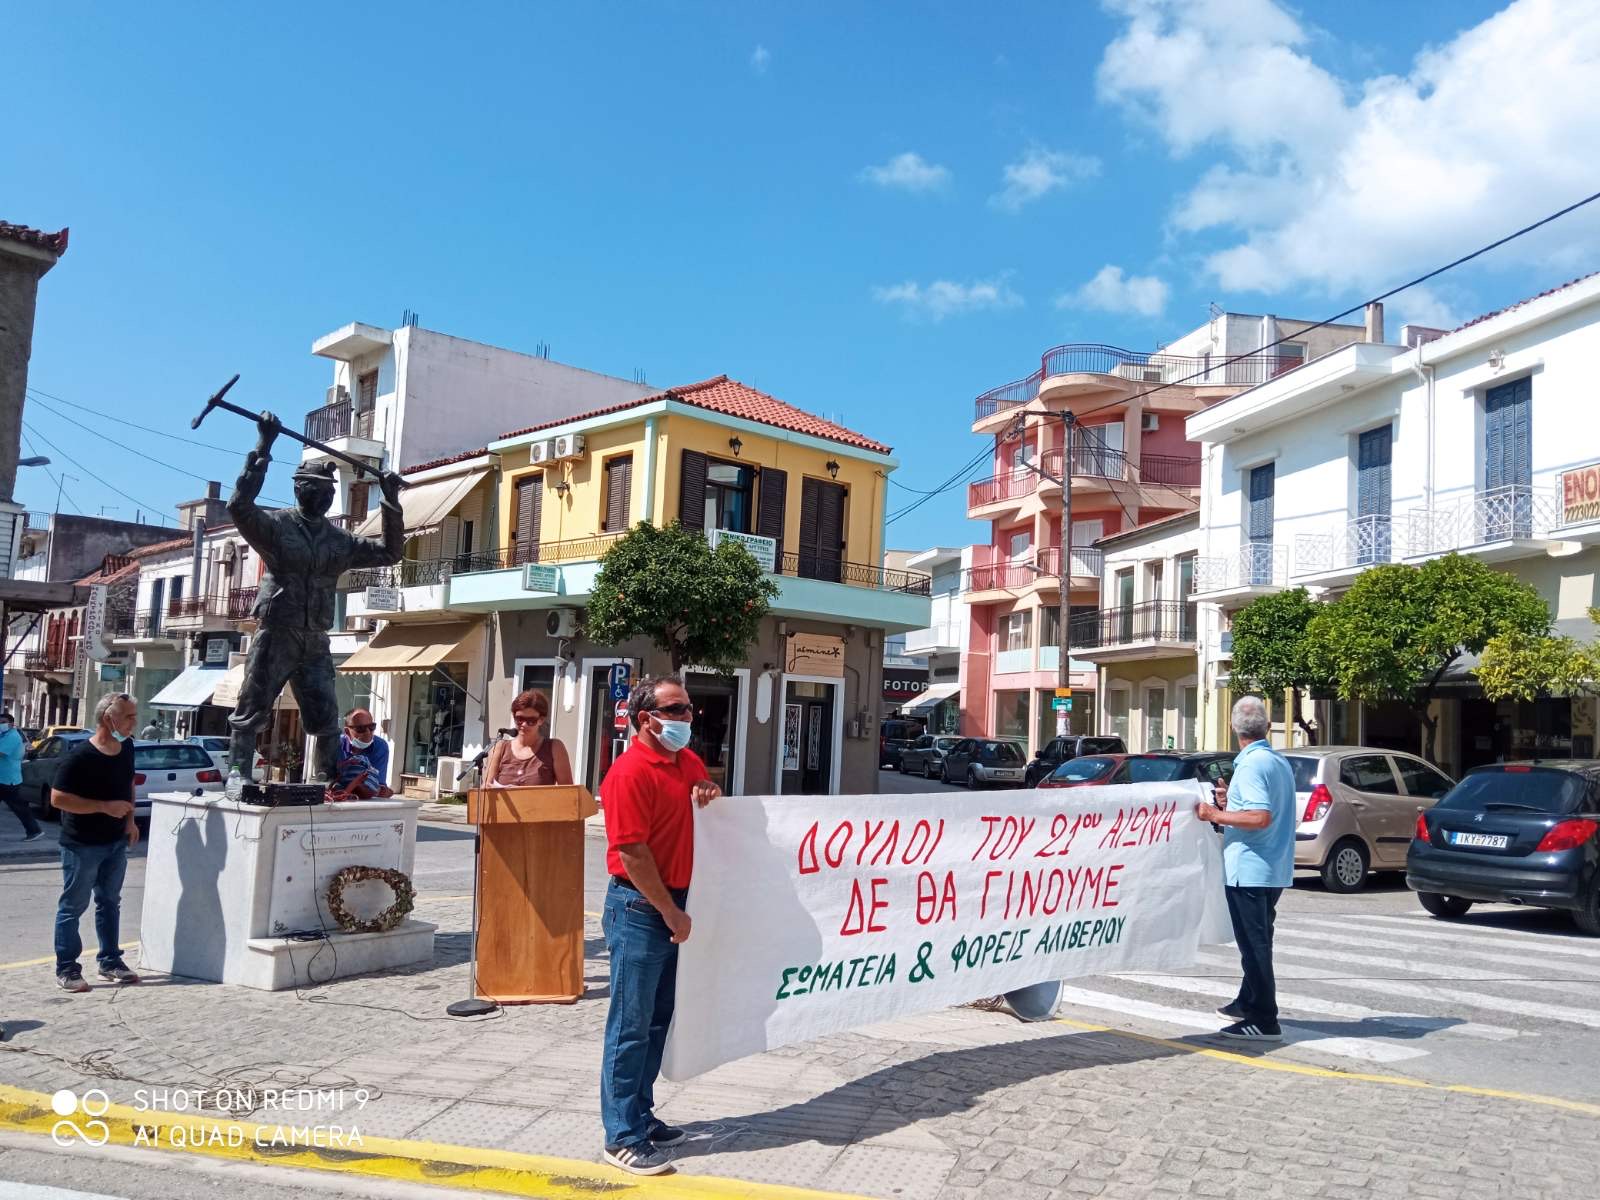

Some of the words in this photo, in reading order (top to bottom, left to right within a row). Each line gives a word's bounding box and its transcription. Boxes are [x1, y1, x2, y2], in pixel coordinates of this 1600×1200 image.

[1564, 468, 1600, 506] ΕΝΟ
[615, 665, 627, 684] P
[798, 819, 944, 874] ΔΟΥΛΟΙ
[972, 816, 1036, 861] ΤΟΥ
[1098, 801, 1176, 849] ΑΙΩΝΑ
[840, 878, 888, 935] ΔΕ
[916, 871, 956, 924] ΘΑ
[980, 865, 1124, 920] ΓΙΝΟΥΜΕ
[776, 952, 896, 1000] ΣΩΜΑΤΕΙΑ
[909, 941, 934, 983] &
[951, 928, 1030, 972] ΦΟΡΕΙΣ
[1034, 915, 1126, 954] ΑΛΙΒΕΡΙΟΥ
